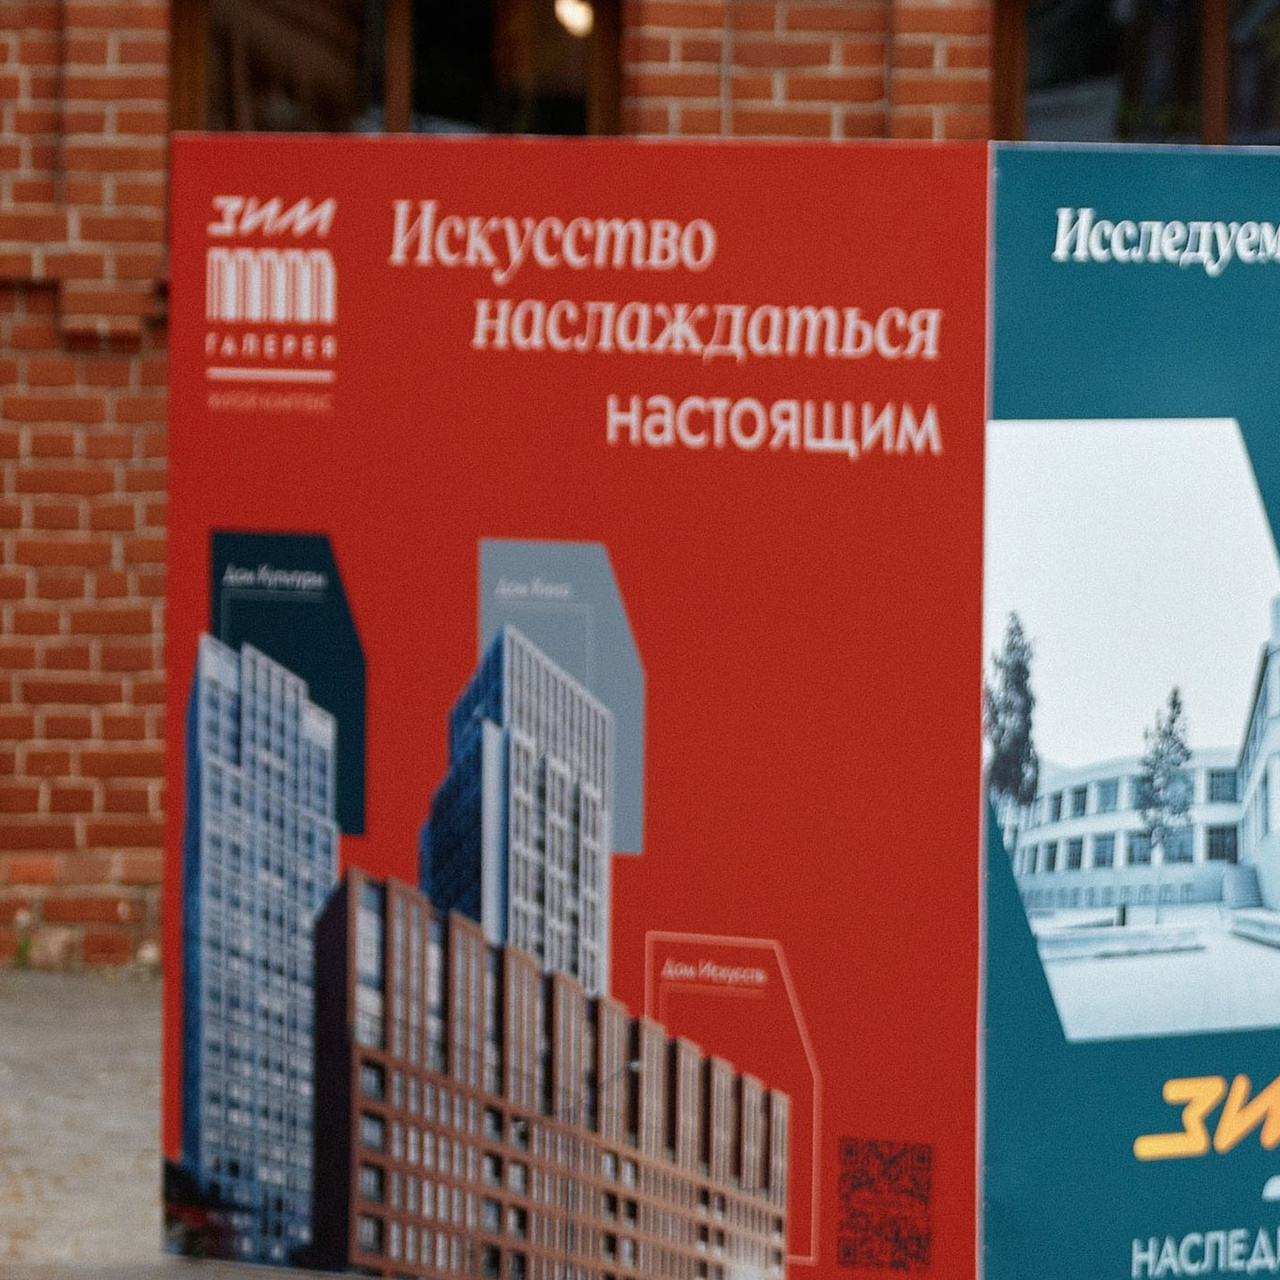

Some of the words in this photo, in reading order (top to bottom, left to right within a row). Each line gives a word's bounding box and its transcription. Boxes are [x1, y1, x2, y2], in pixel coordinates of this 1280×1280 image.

[207, 195, 337, 237] ЗИМ
[389, 199, 717, 286] Искусство
[205, 331, 338, 359] ГАЛЕРЕЯ
[470, 298, 942, 364] наслаждаться
[605, 393, 944, 461] настоящим
